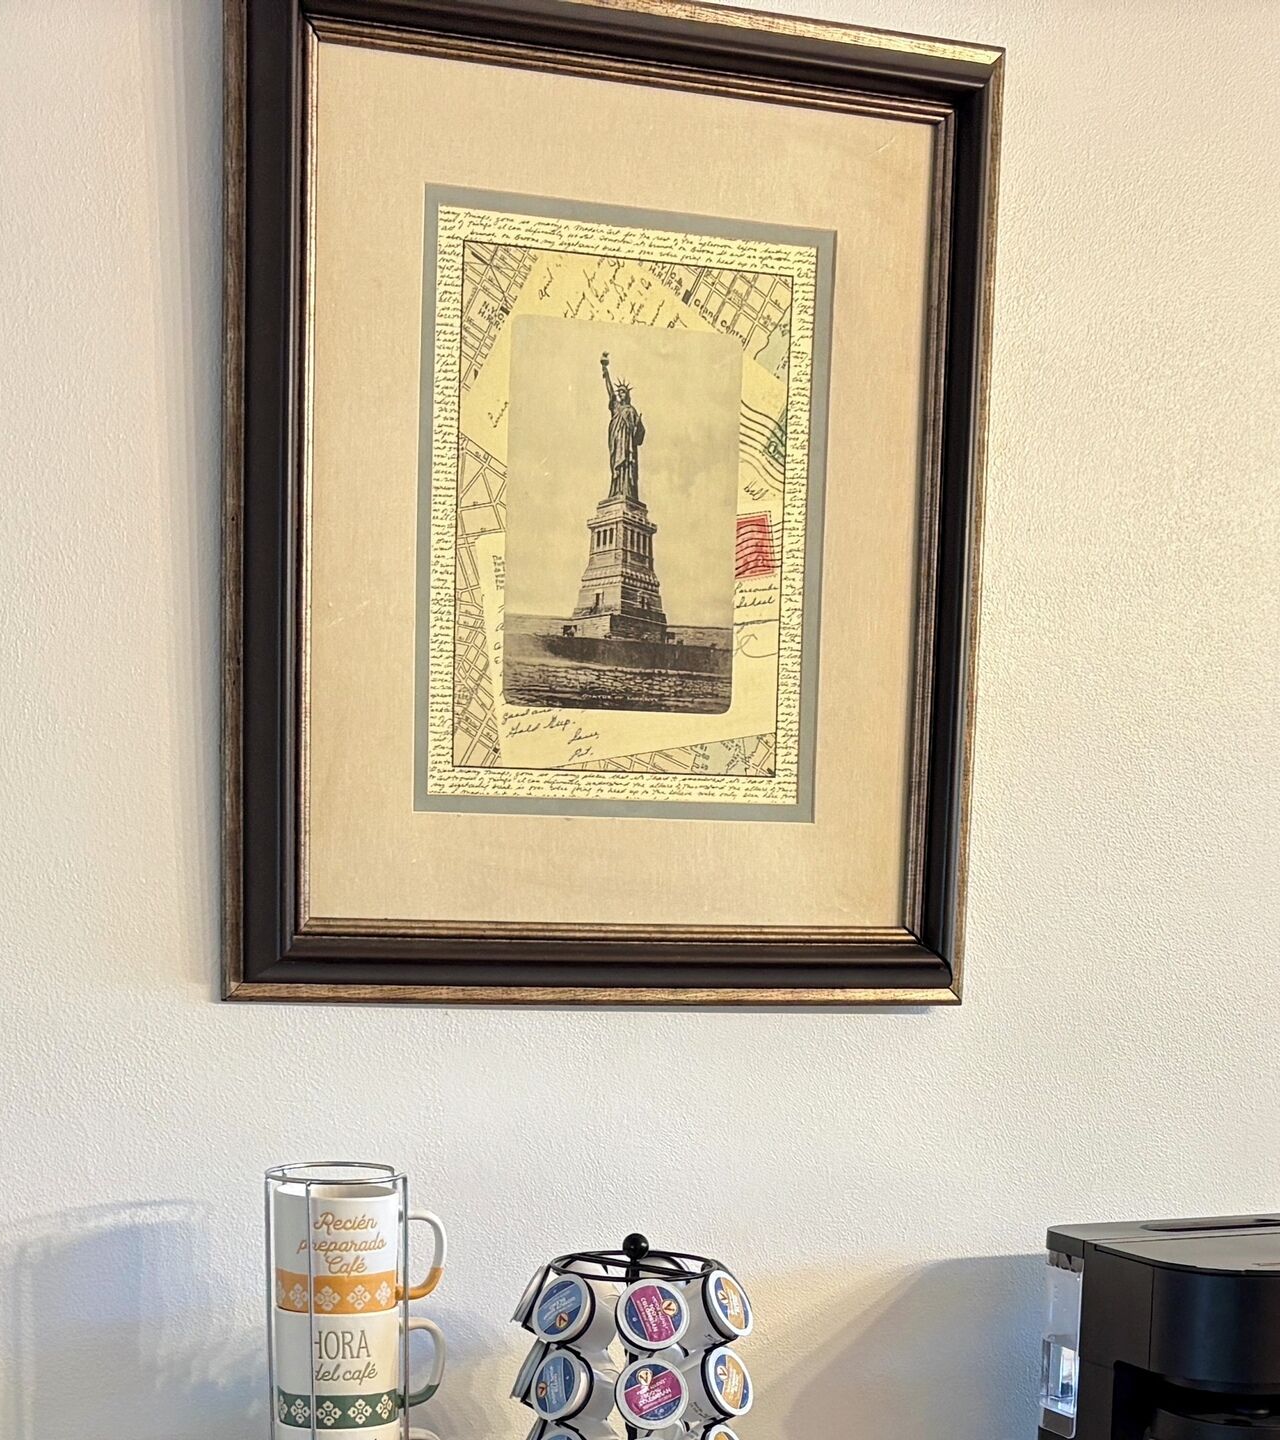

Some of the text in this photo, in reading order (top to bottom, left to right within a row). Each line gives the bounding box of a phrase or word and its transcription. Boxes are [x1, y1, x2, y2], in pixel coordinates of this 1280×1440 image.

[313, 1210, 378, 1236] Recién
[296, 1232, 387, 1261] preparado
[325, 1254, 368, 1277] Café
[345, 1361, 378, 1387] café
